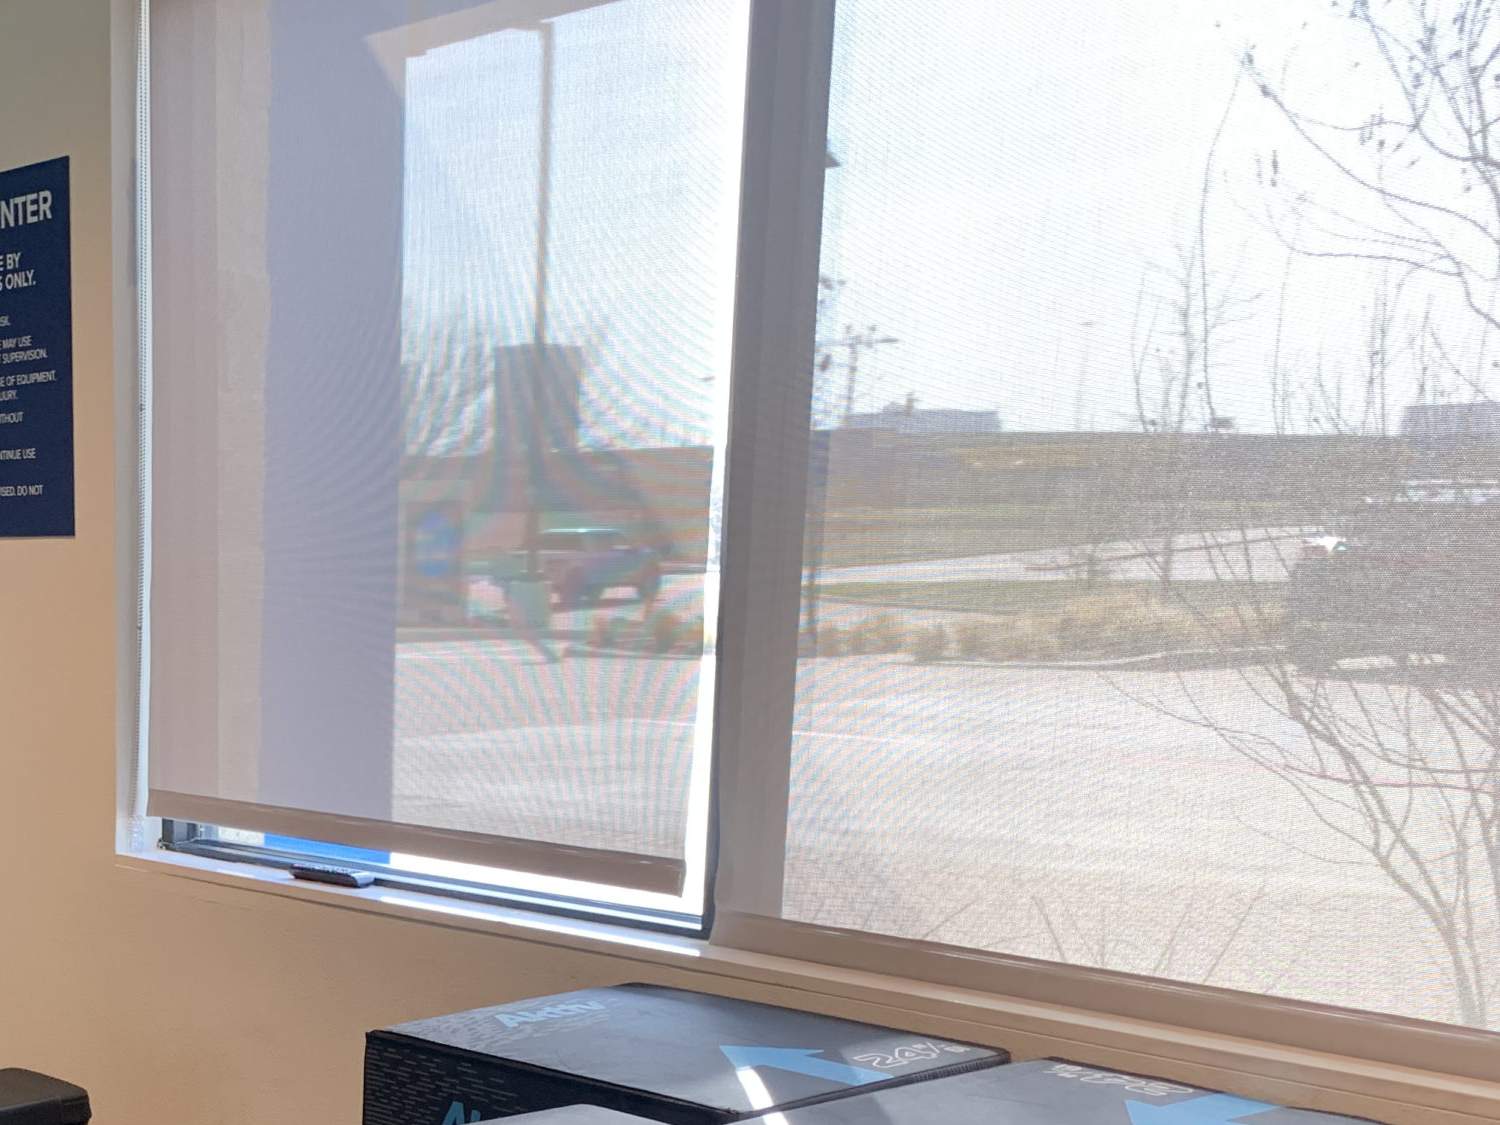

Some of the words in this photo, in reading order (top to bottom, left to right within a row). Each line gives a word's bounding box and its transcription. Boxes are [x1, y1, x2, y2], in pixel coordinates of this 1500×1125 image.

[6, 252, 20, 269] BY
[5, 269, 35, 289] ONLY.
[494, 1000, 606, 1028] Aktiv
